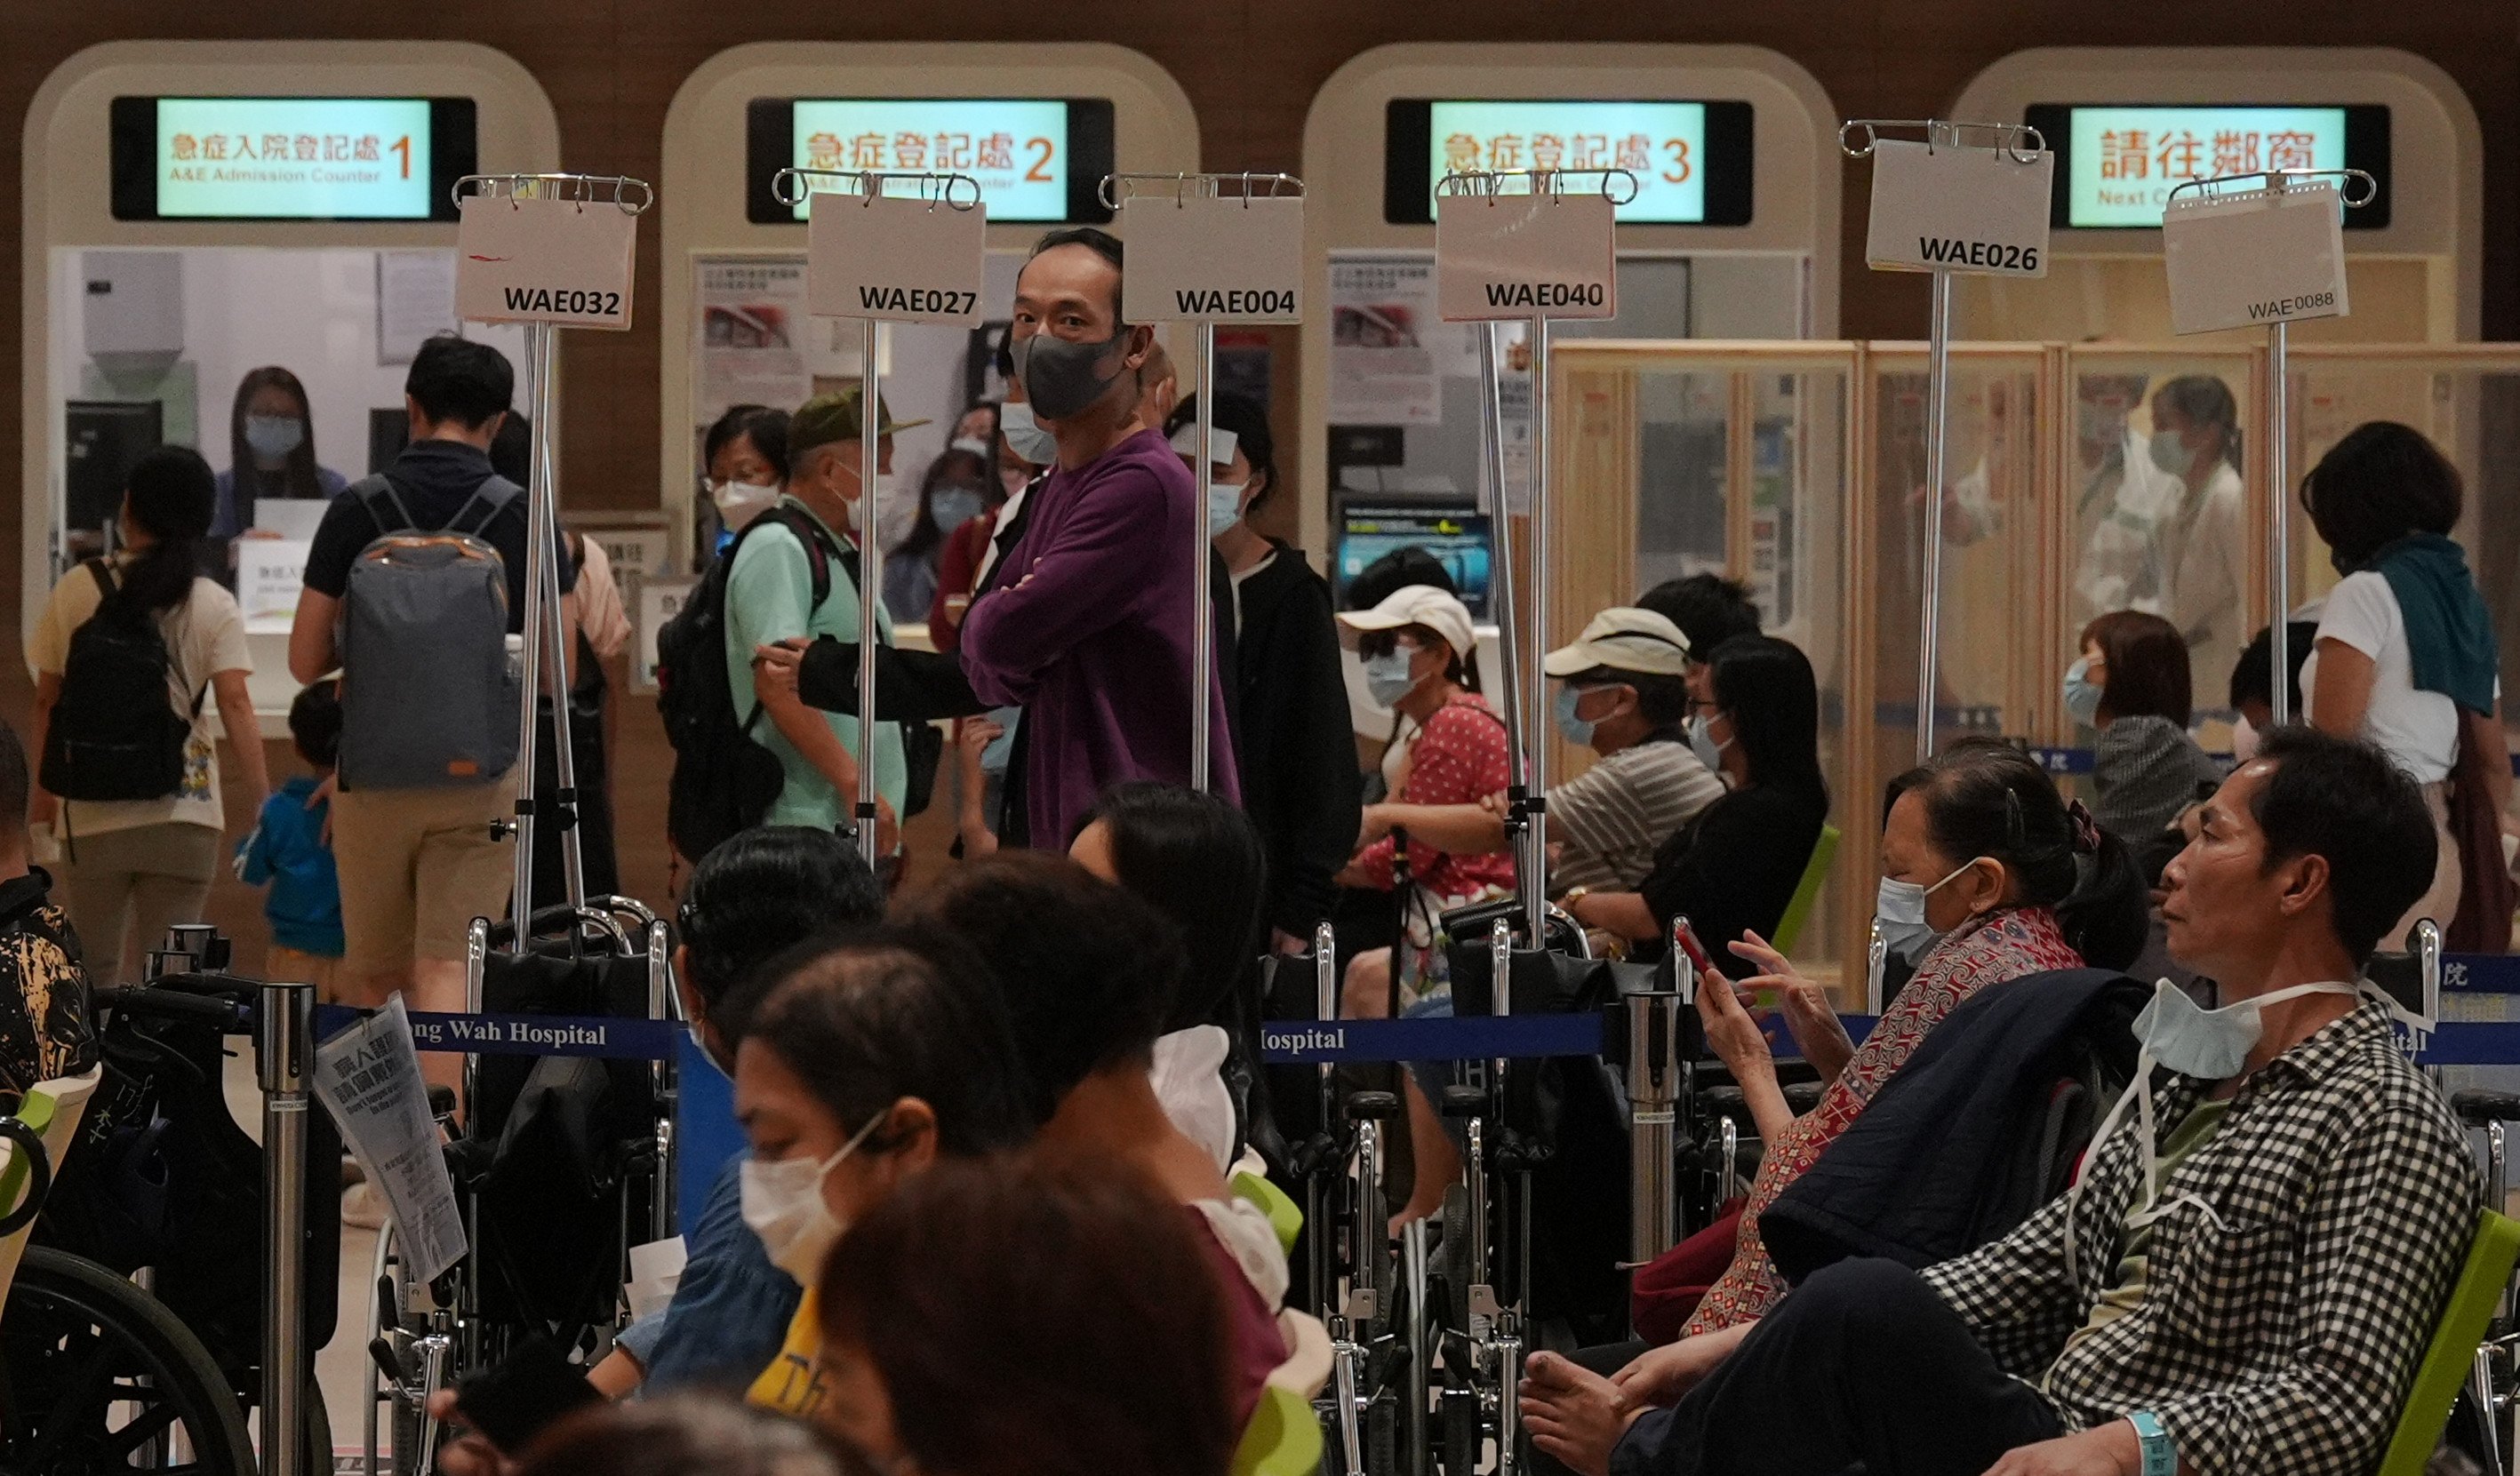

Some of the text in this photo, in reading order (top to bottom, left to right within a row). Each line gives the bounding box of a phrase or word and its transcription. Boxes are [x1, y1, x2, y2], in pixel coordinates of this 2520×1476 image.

[172, 133, 412, 180] 急症入院登記處 1
[807, 132, 1053, 182] 急症登記處 2
[1444, 133, 1691, 183] 急症登記處 3
[169, 167, 205, 183] A&E
[311, 167, 380, 183] Counter
[1919, 236, 2038, 271] WAE026
[505, 287, 620, 315] WAE032
[860, 286, 976, 315] WAE027
[1176, 290, 1295, 314] WAE004
[1485, 283, 1604, 307] WAE040
[2248, 291, 2334, 319] WAE0088
[448, 1020, 501, 1041] Wah
[508, 1022, 605, 1049] Hospital
